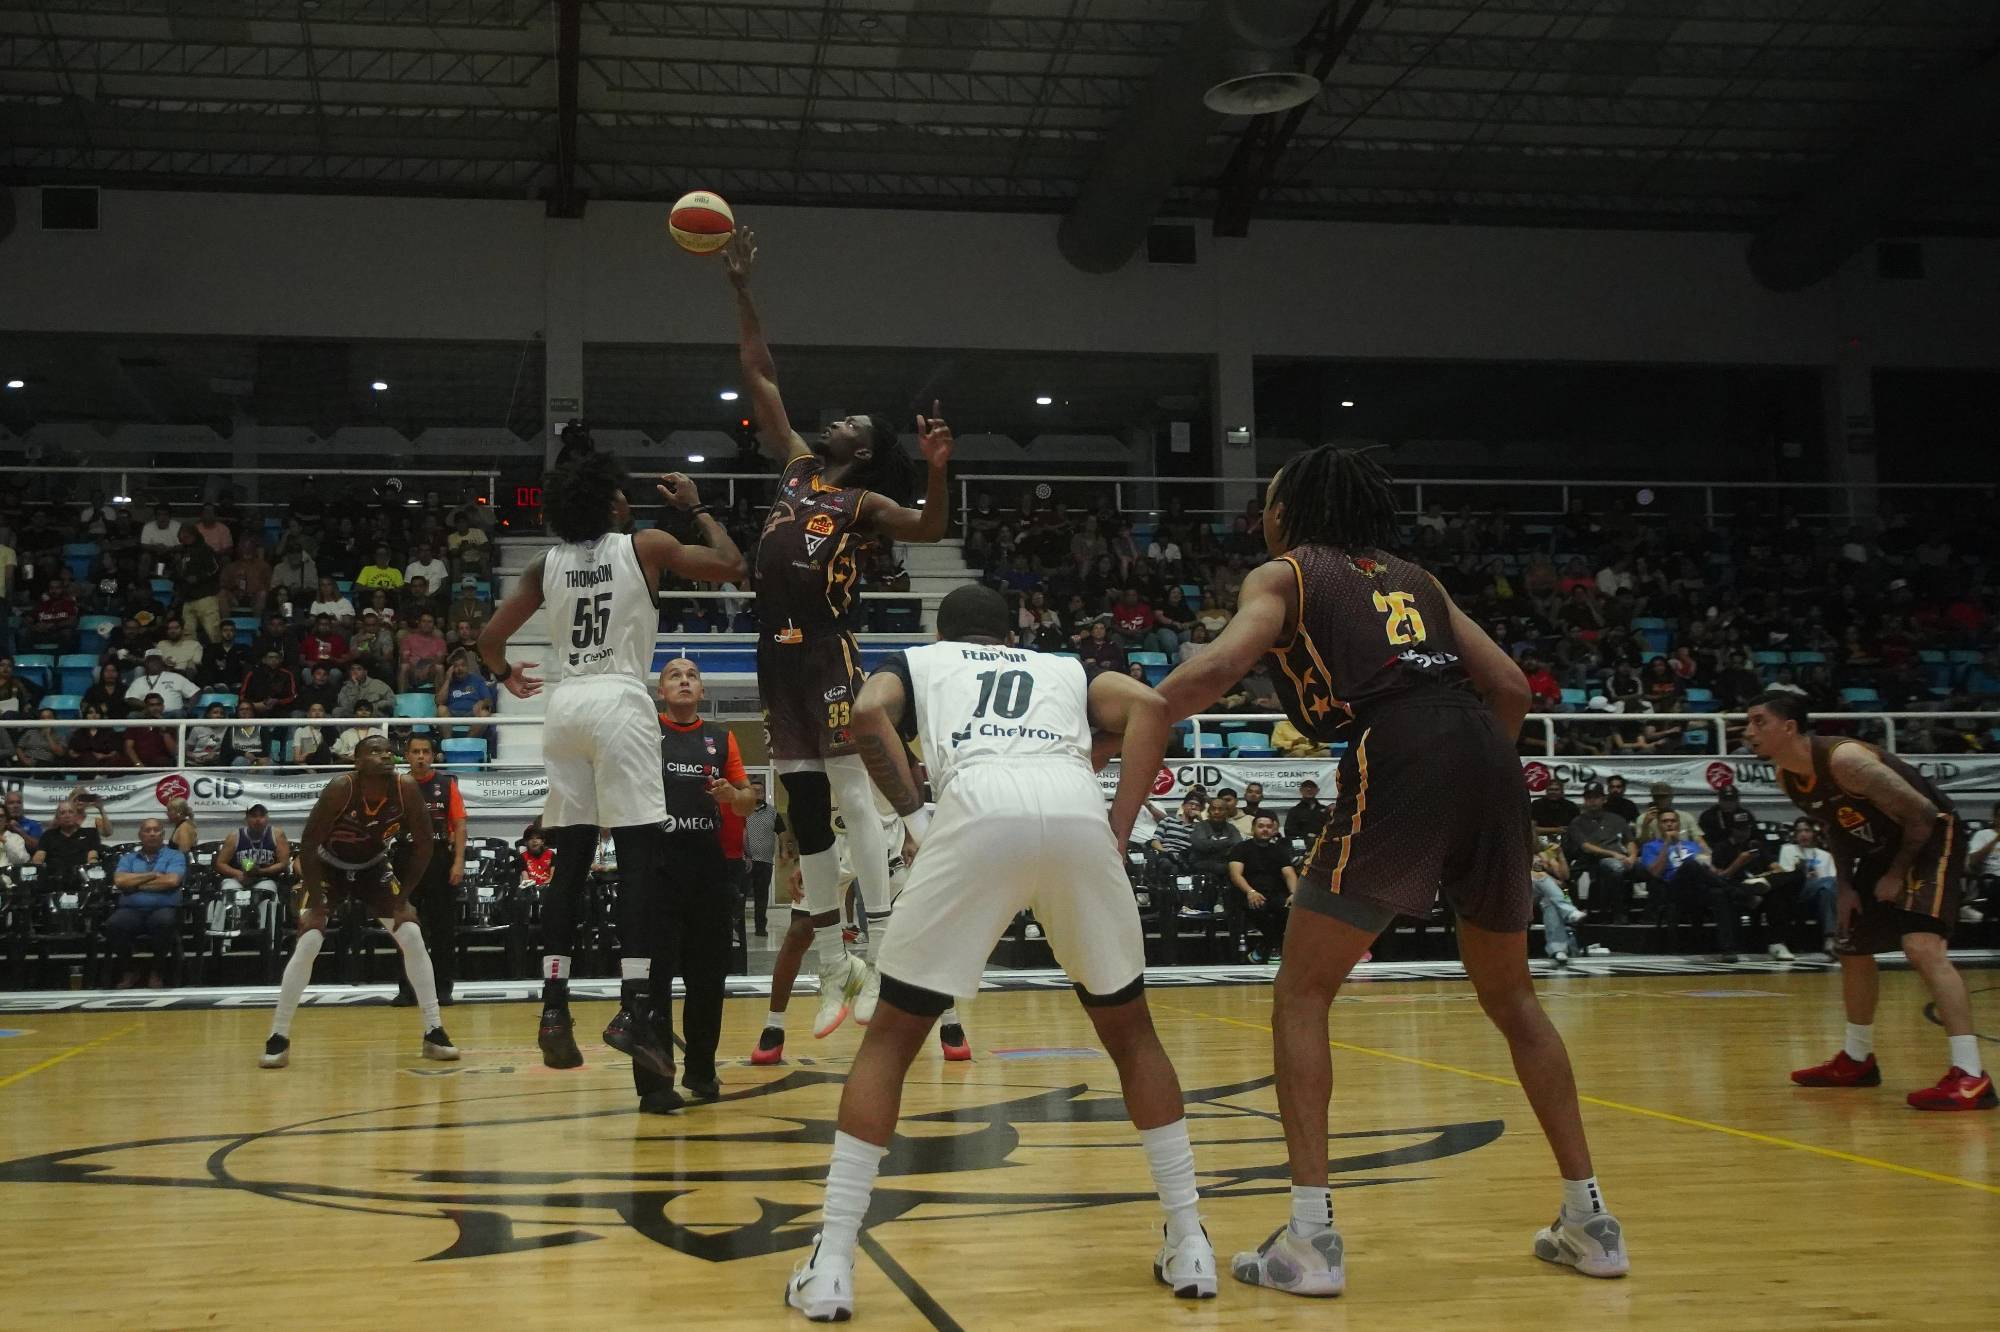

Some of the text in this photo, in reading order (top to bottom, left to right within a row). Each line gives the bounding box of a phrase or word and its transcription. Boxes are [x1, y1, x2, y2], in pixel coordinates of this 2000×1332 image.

[572, 592, 613, 649] 55
[1373, 590, 1426, 645] 25
[972, 669, 1034, 719] 10
[827, 701, 850, 728] 33
[476, 779, 518, 787] SIEMPRE
[1176, 765, 1223, 787] CID
[1553, 764, 1597, 783] CID
[193, 777, 244, 799] CID
[270, 791, 313, 800] SIEMPRE
[483, 788, 526, 797] SIEMPRE
